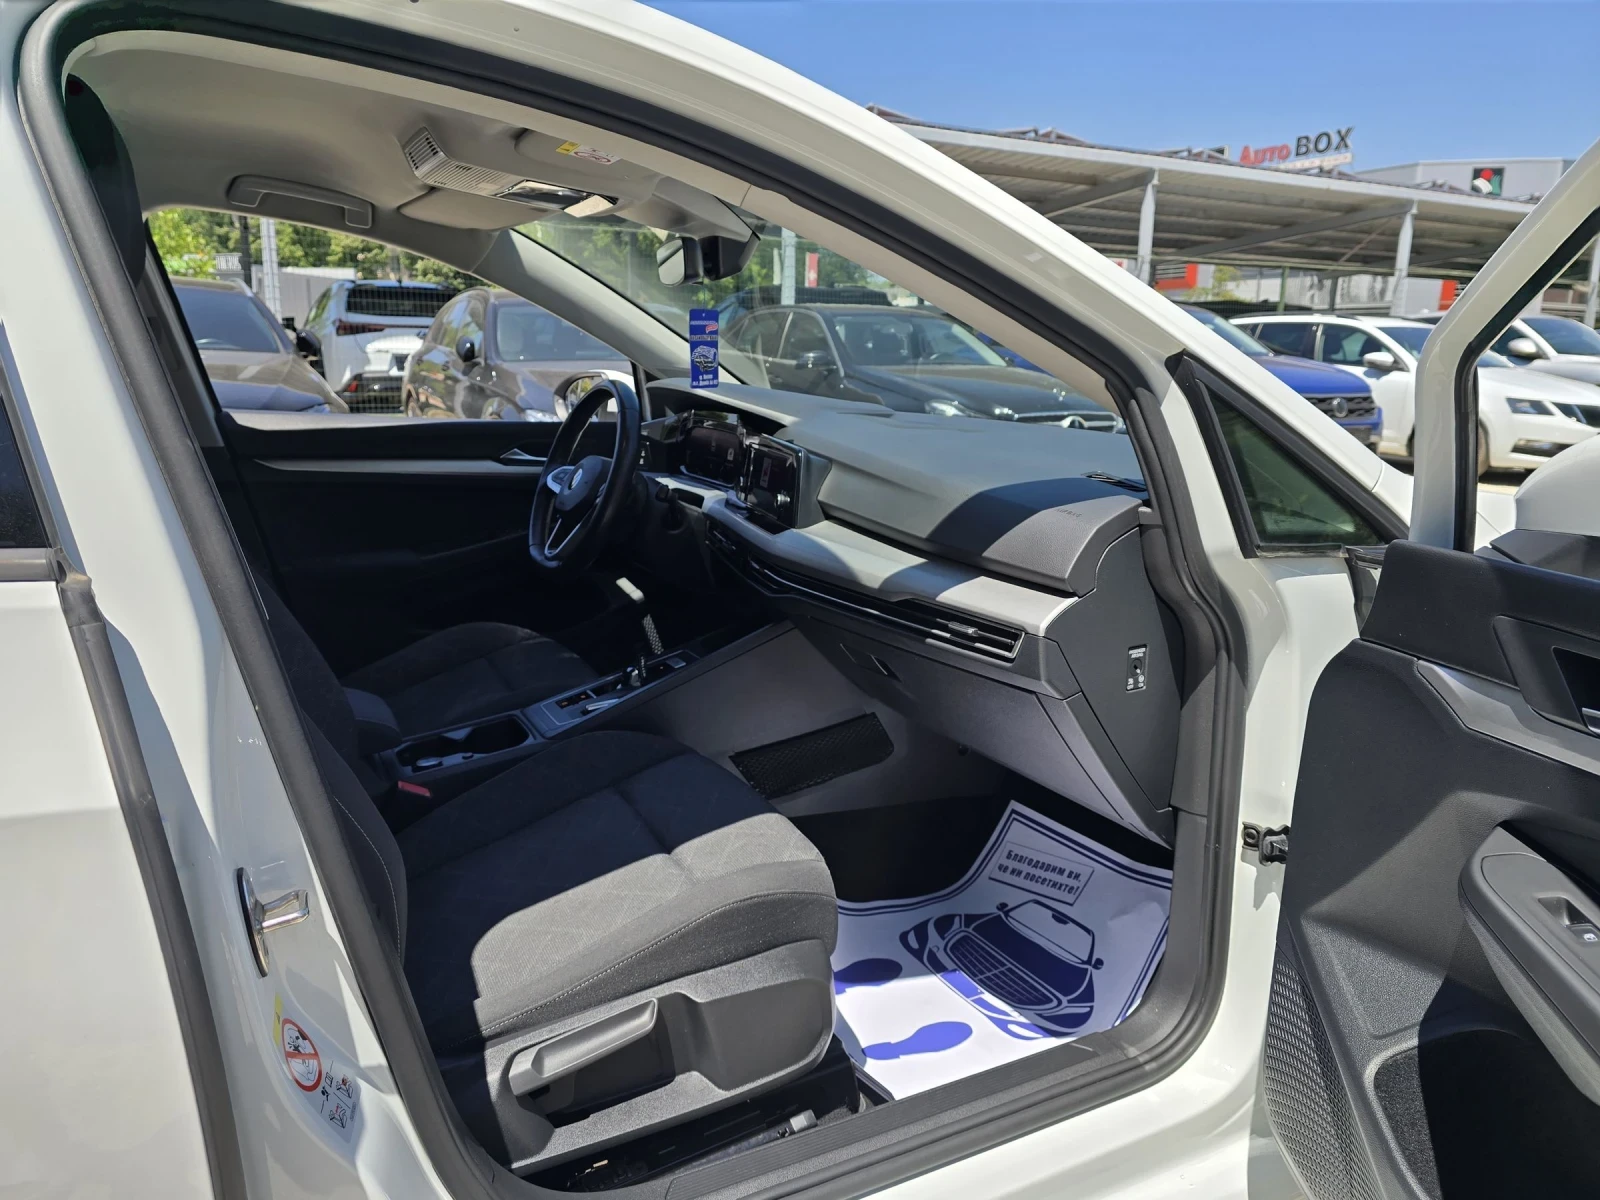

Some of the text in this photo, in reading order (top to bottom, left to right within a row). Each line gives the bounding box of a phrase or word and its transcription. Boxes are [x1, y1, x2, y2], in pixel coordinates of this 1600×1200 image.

[1295, 126, 1354, 157] BOX
[1005, 849, 1067, 877] Благодарим
[997, 863, 1081, 896] че ни посетихте!
